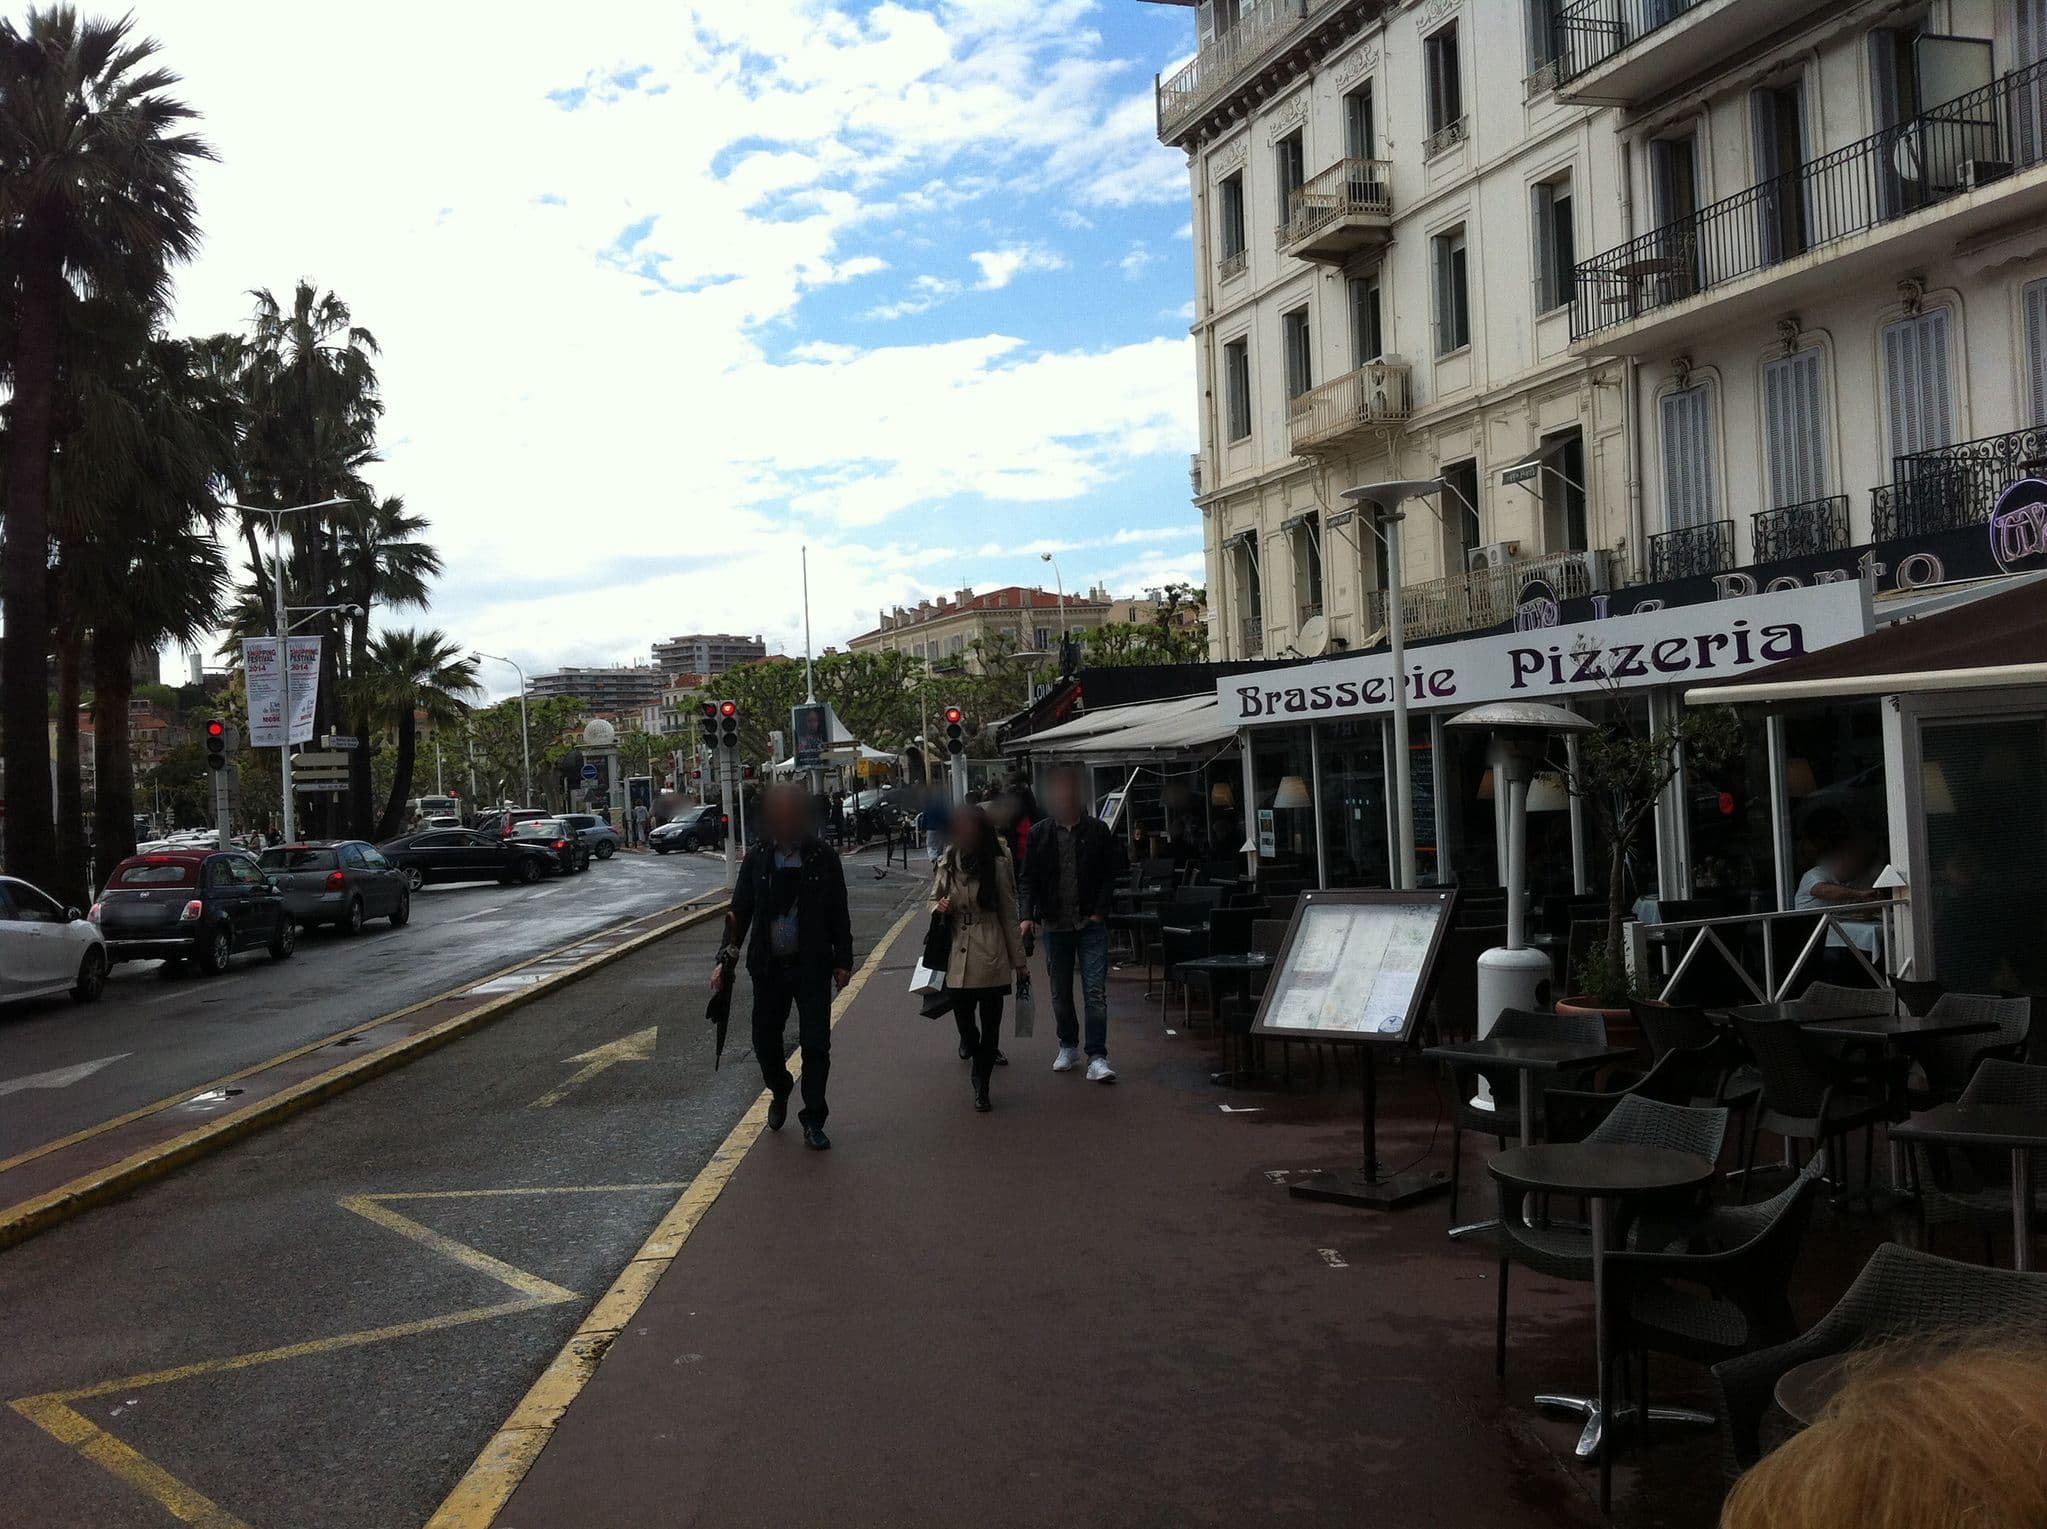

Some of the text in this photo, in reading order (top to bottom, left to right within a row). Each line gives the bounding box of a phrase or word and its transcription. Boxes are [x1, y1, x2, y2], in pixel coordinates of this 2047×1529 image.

[1507, 620, 1809, 689] Pizzeria
[247, 655, 274, 663] FESTIVAL
[248, 664, 266, 672] 2014
[290, 663, 309, 671] 2014
